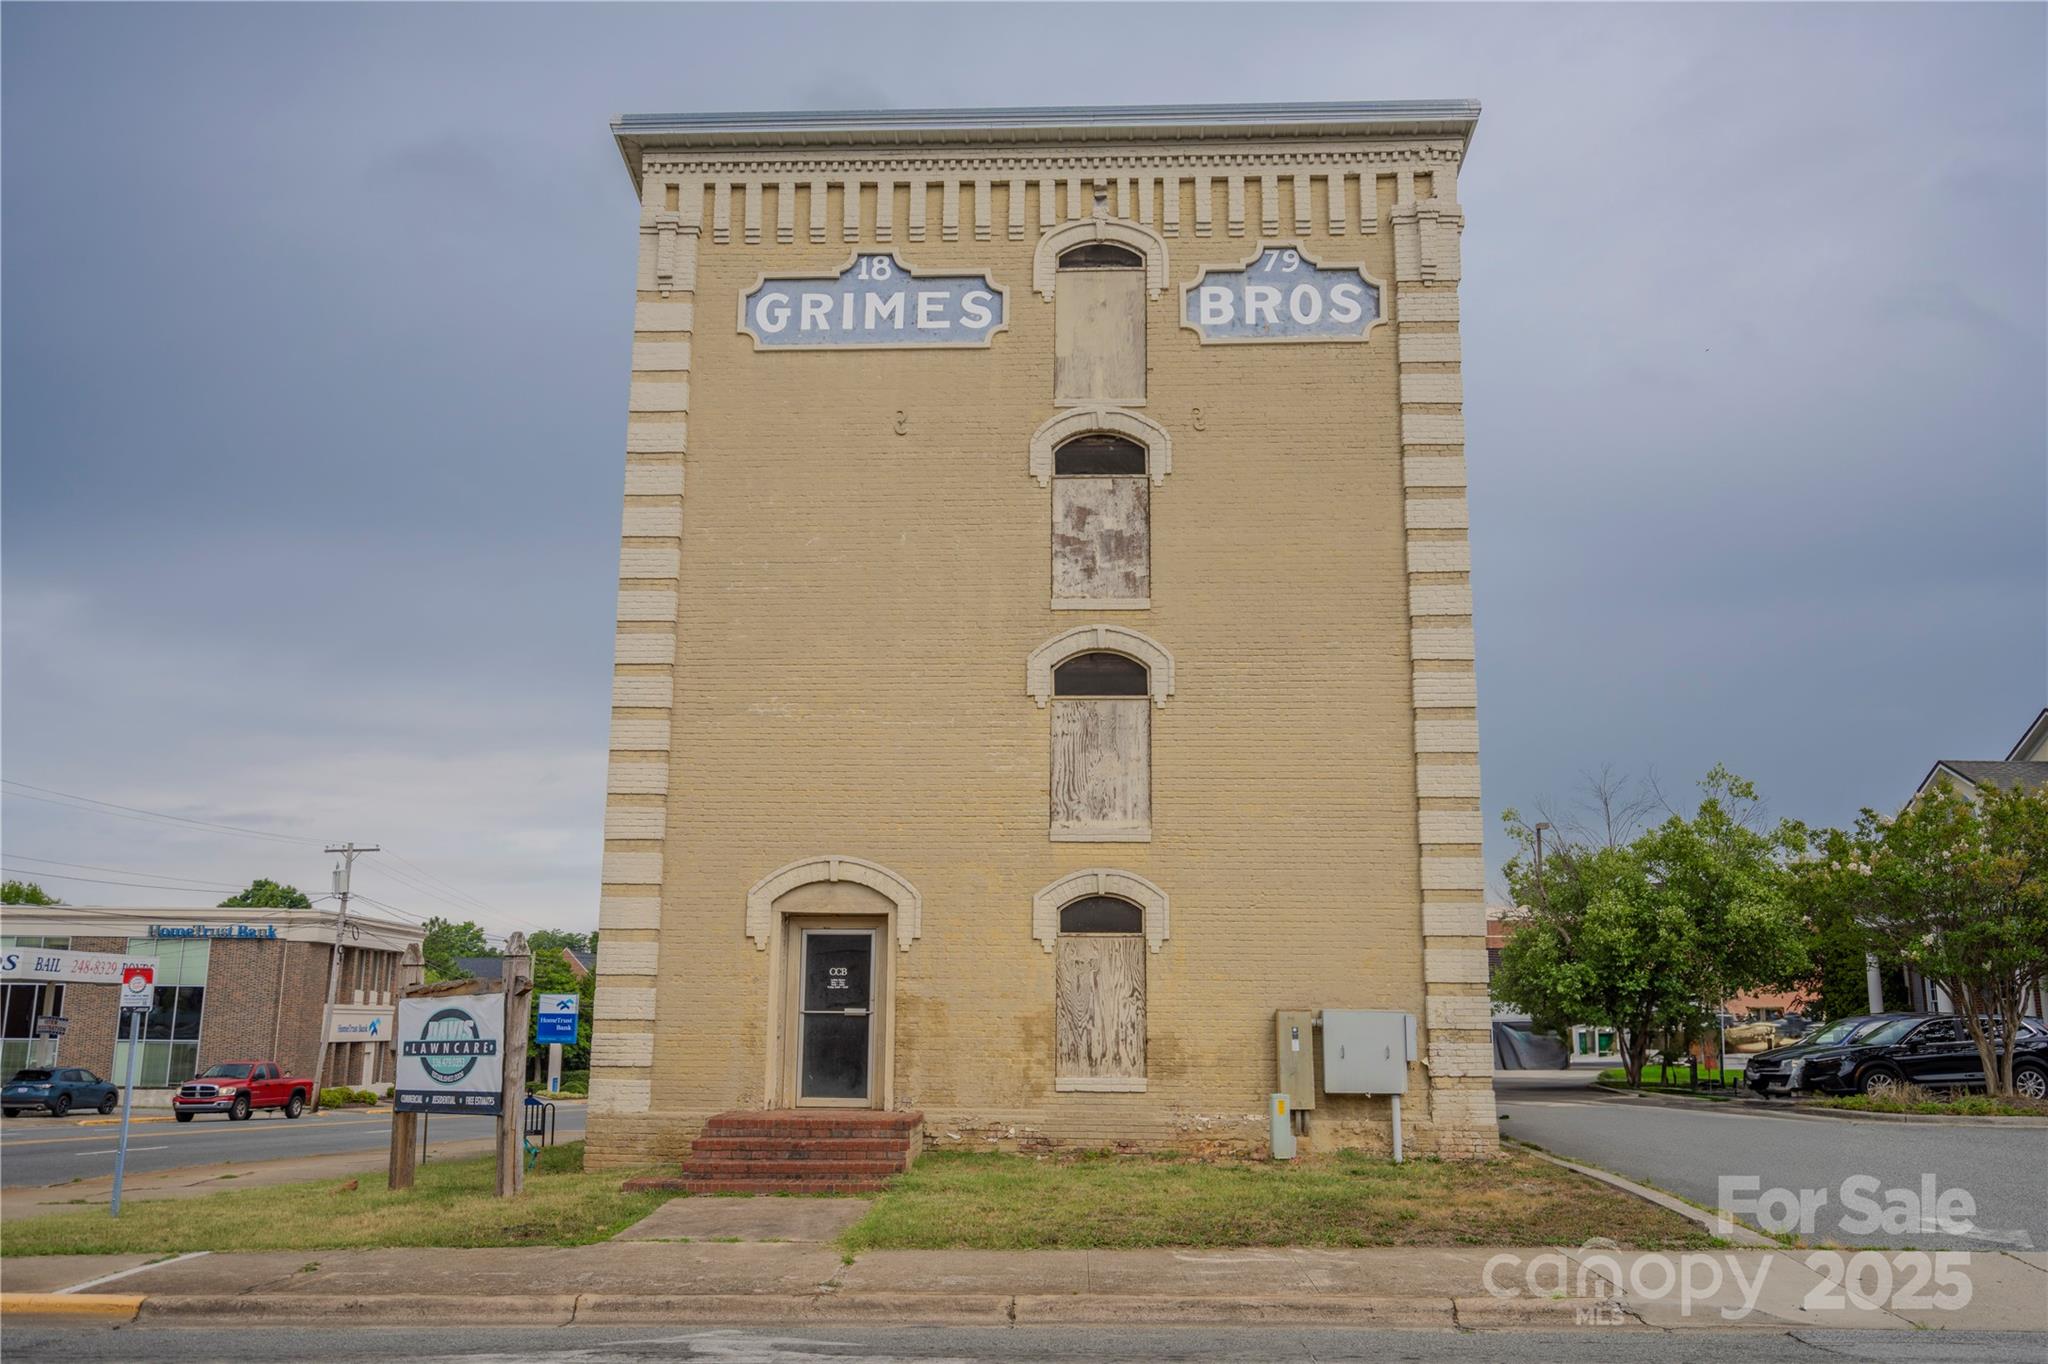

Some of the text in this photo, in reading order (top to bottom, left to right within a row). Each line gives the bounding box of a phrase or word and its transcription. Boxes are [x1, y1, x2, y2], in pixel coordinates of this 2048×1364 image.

[857, 256, 891, 280] 18
[1264, 250, 1300, 273] 79
[755, 291, 992, 333] GRIMES
[1201, 284, 1362, 325] BROS
[148, 924, 277, 939] HomeTrust Bank
[34, 957, 61, 972] BAIL
[829, 967, 848, 976] OCB
[411, 1042, 489, 1054] LAWNCARE
